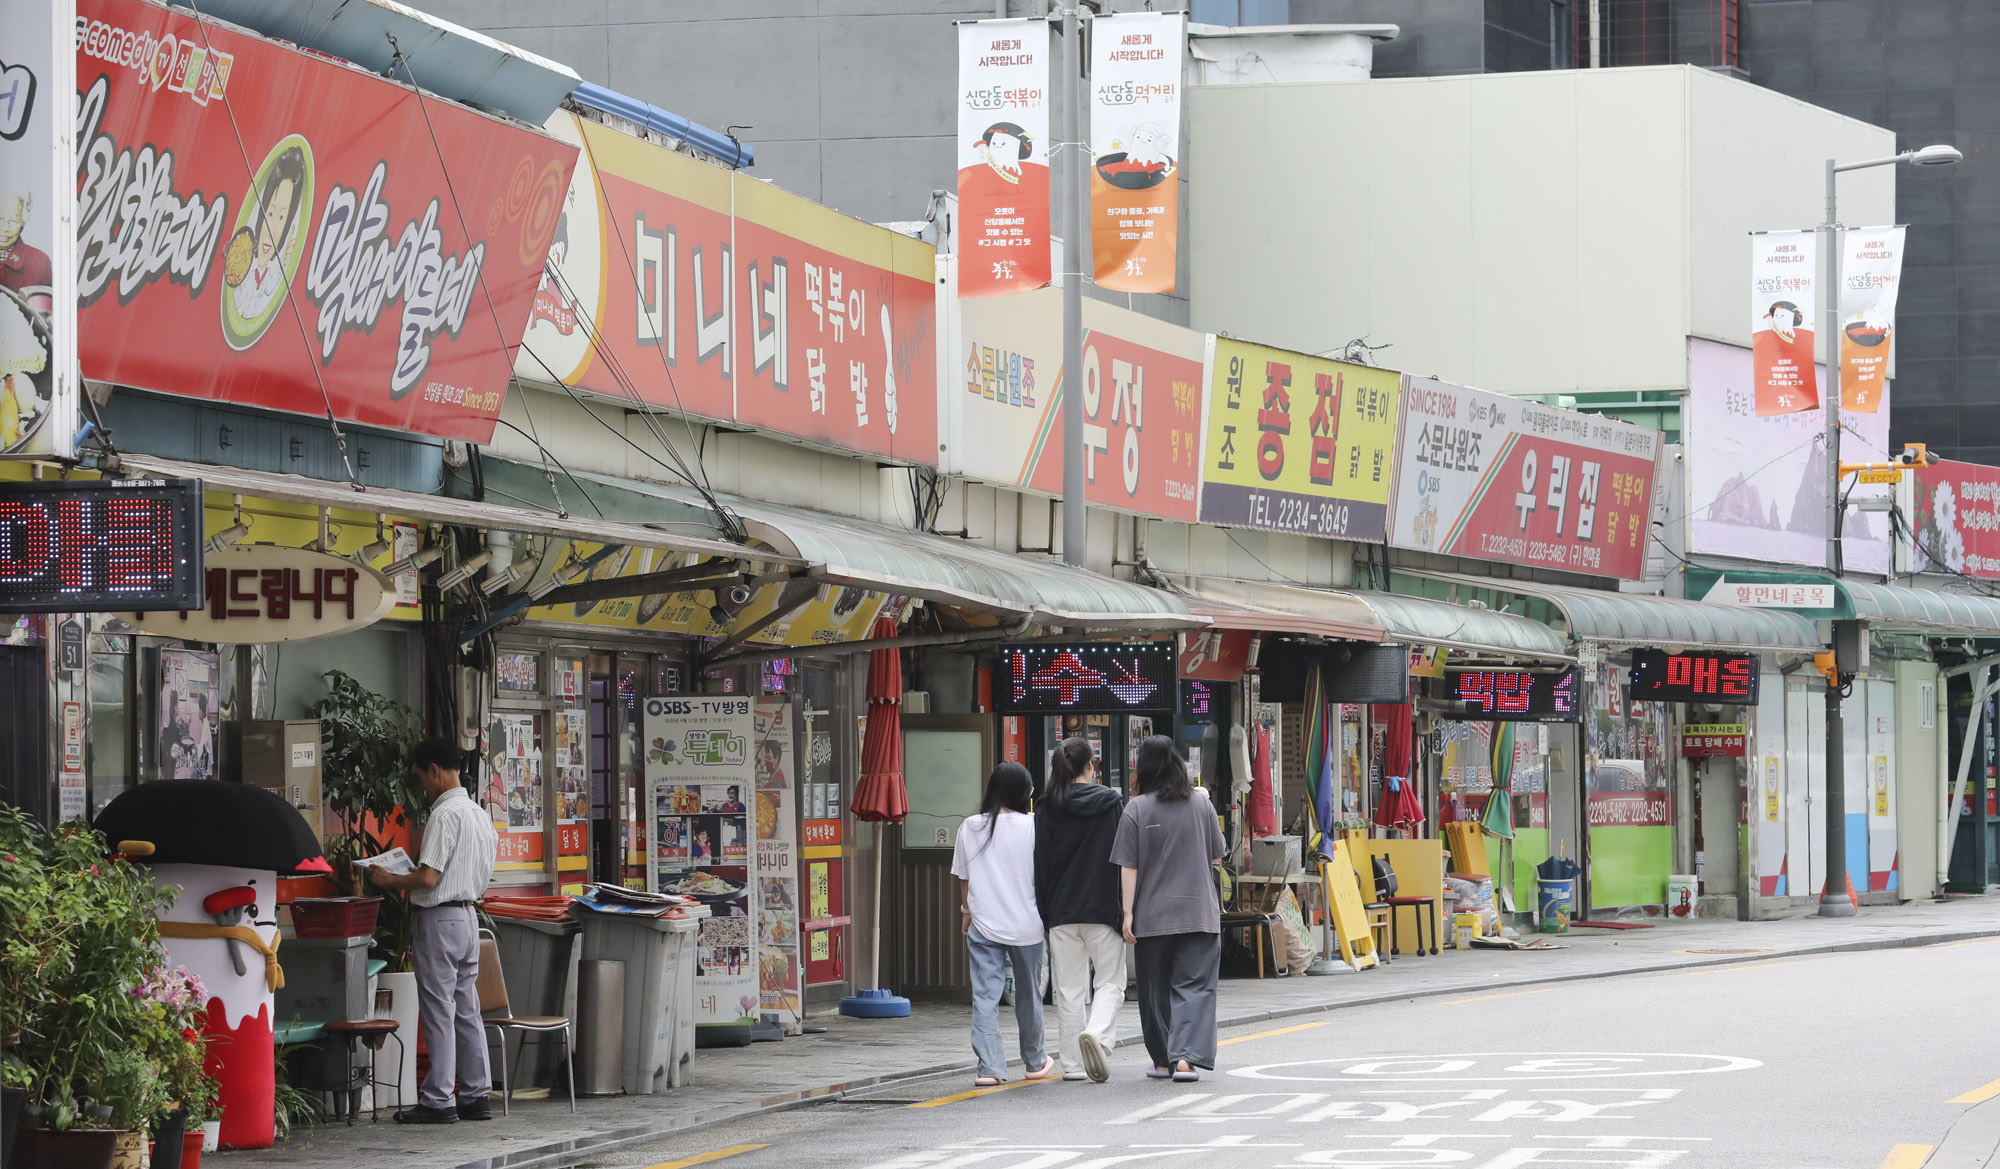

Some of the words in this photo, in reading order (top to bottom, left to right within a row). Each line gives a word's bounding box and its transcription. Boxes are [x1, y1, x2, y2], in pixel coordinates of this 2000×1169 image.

[990, 39, 1022, 51] 새롭게
[1120, 34, 1152, 46] 새롭게
[978, 54, 1033, 68] 시작합니다!
[1108, 48, 1164, 62] 시작합니다!
[634, 211, 789, 394] 미니네
[804, 261, 866, 345] 떡볶이
[967, 341, 1036, 409] 소문난원조
[462, 386, 482, 409] Since
[482, 391, 500, 412] 1953
[1172, 380, 1195, 420] 떡볶이
[1356, 386, 1390, 425] 떡볶이
[1410, 386, 1438, 416] SINCE
[1438, 393, 1457, 421] 1984
[1257, 360, 1344, 487] 종점
[1416, 422, 1482, 473] 소문난원조
[1428, 476, 1441, 493] SBS
[1515, 449, 1600, 542] 우리집
[1612, 472, 1645, 507] 떡볶이
[66, 645, 77, 664] 51
[689, 732, 707, 740] 생방송
[1685, 737, 1703, 748] 토토
[1704, 737, 1722, 748] 담배
[1724, 737, 1743, 748] 수퍼
[685, 738, 743, 763] 투데이
[700, 995, 716, 1015] 네
